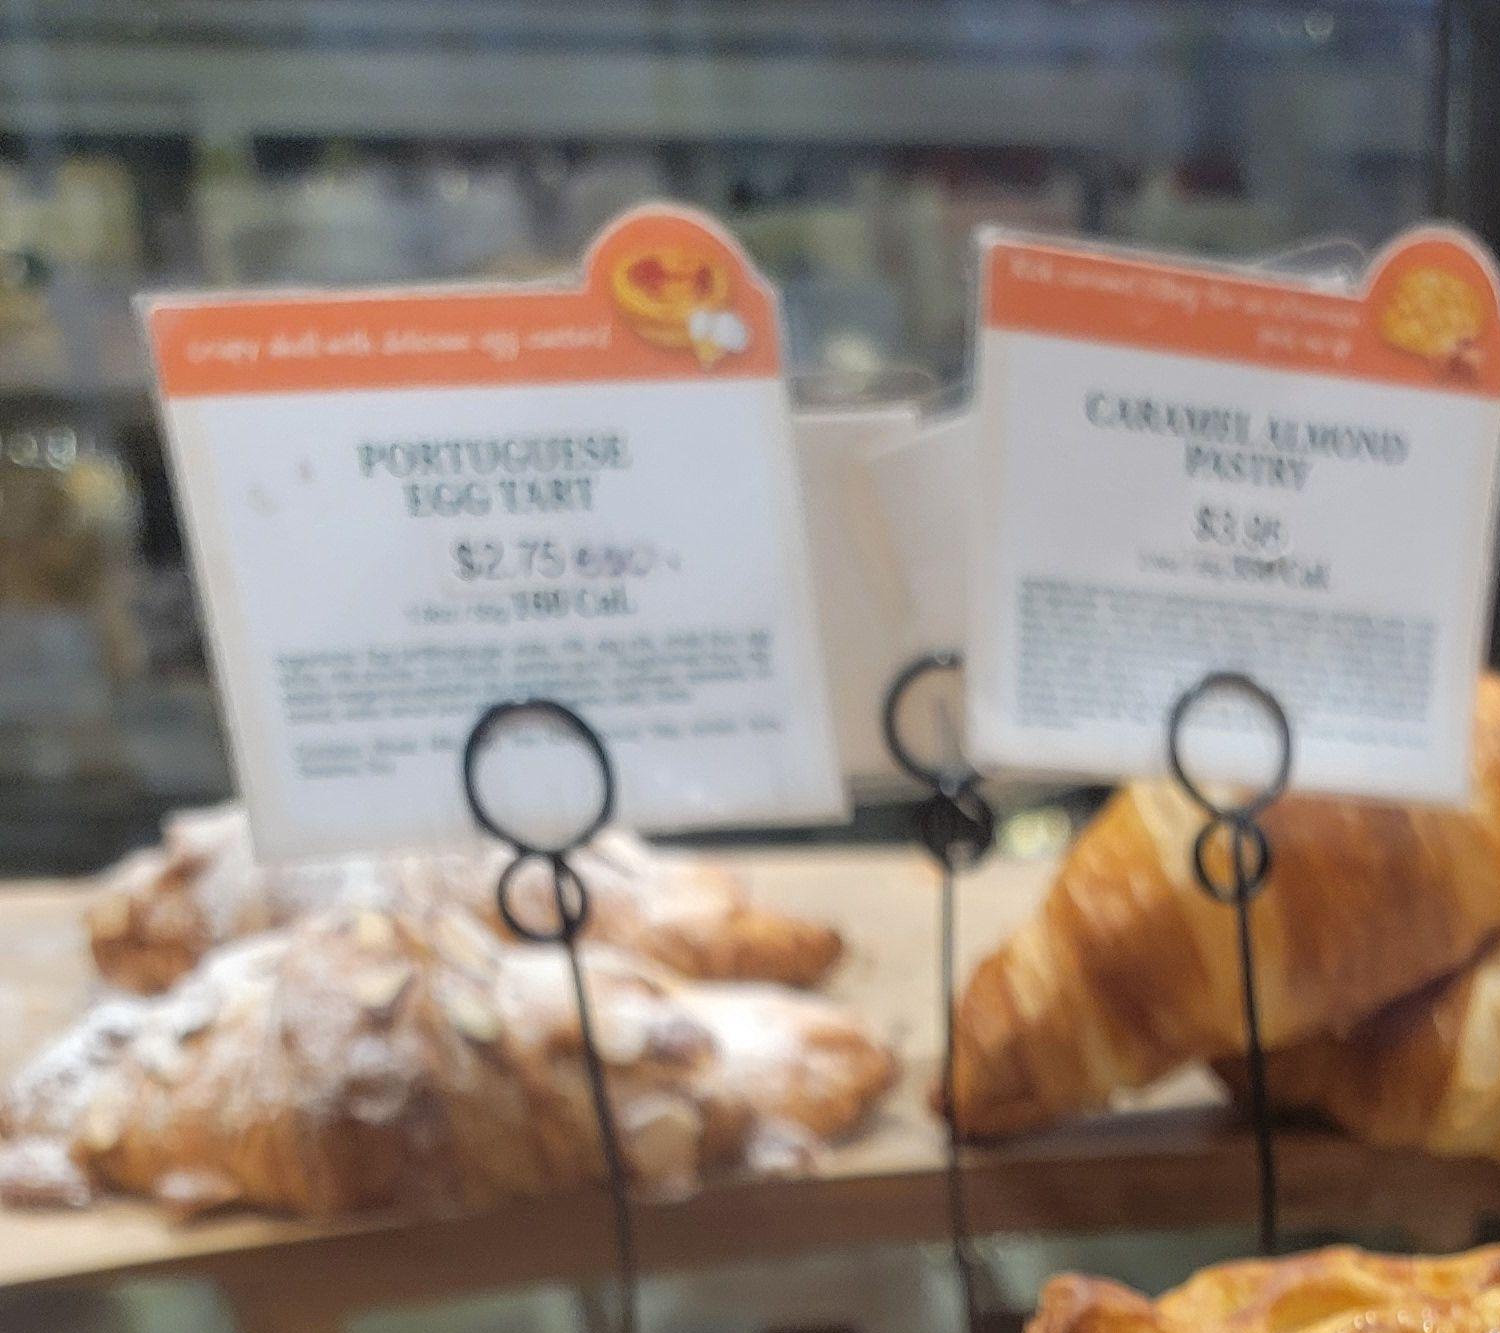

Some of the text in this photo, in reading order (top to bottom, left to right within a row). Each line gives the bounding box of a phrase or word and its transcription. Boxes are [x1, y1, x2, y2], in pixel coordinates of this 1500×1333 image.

[1084, 392, 1410, 467] CARAMEL ALMOND
[356, 436, 633, 478] PORTUGUESE
[1184, 445, 1313, 491] PASTRY
[403, 475, 595, 517] EGG TART
[452, 538, 566, 582] $2.75
